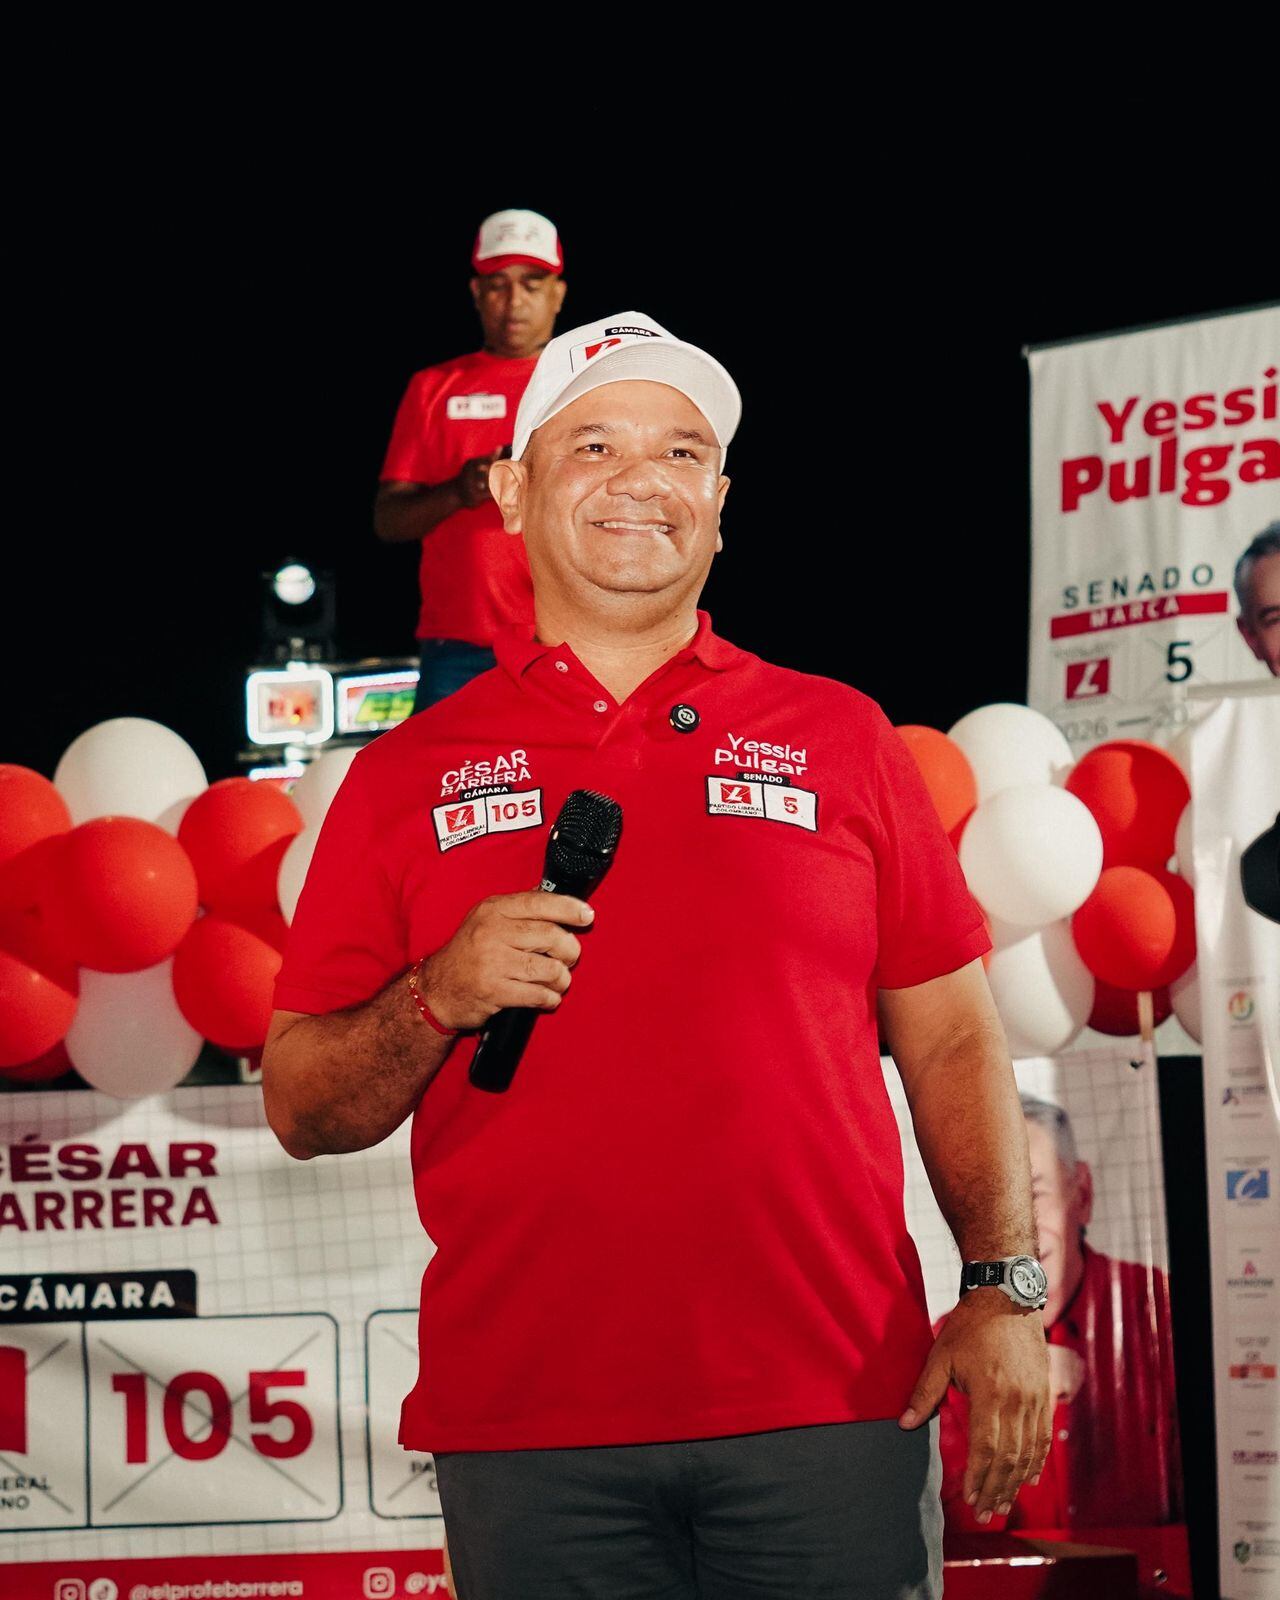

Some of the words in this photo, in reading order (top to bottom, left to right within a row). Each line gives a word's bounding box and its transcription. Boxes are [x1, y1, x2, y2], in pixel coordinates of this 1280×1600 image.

[1063, 563, 1214, 609] SENADO
[1089, 594, 1181, 629] MARCA
[1166, 641, 1193, 683] 5
[714, 748, 808, 776] Pulgar
[727, 732, 807, 764] Yessid
[440, 766, 532, 798] BARRERA
[441, 749, 529, 787] CÉSAR
[743, 773, 783, 784] SENADO
[464, 786, 509, 799] CÁMARA
[783, 795, 799, 815] 5
[491, 799, 537, 823] 105
[0, 1133, 219, 1182] ÉSAR
[0, 1277, 176, 1311] CÁMARA
[112, 1369, 315, 1465] 105
